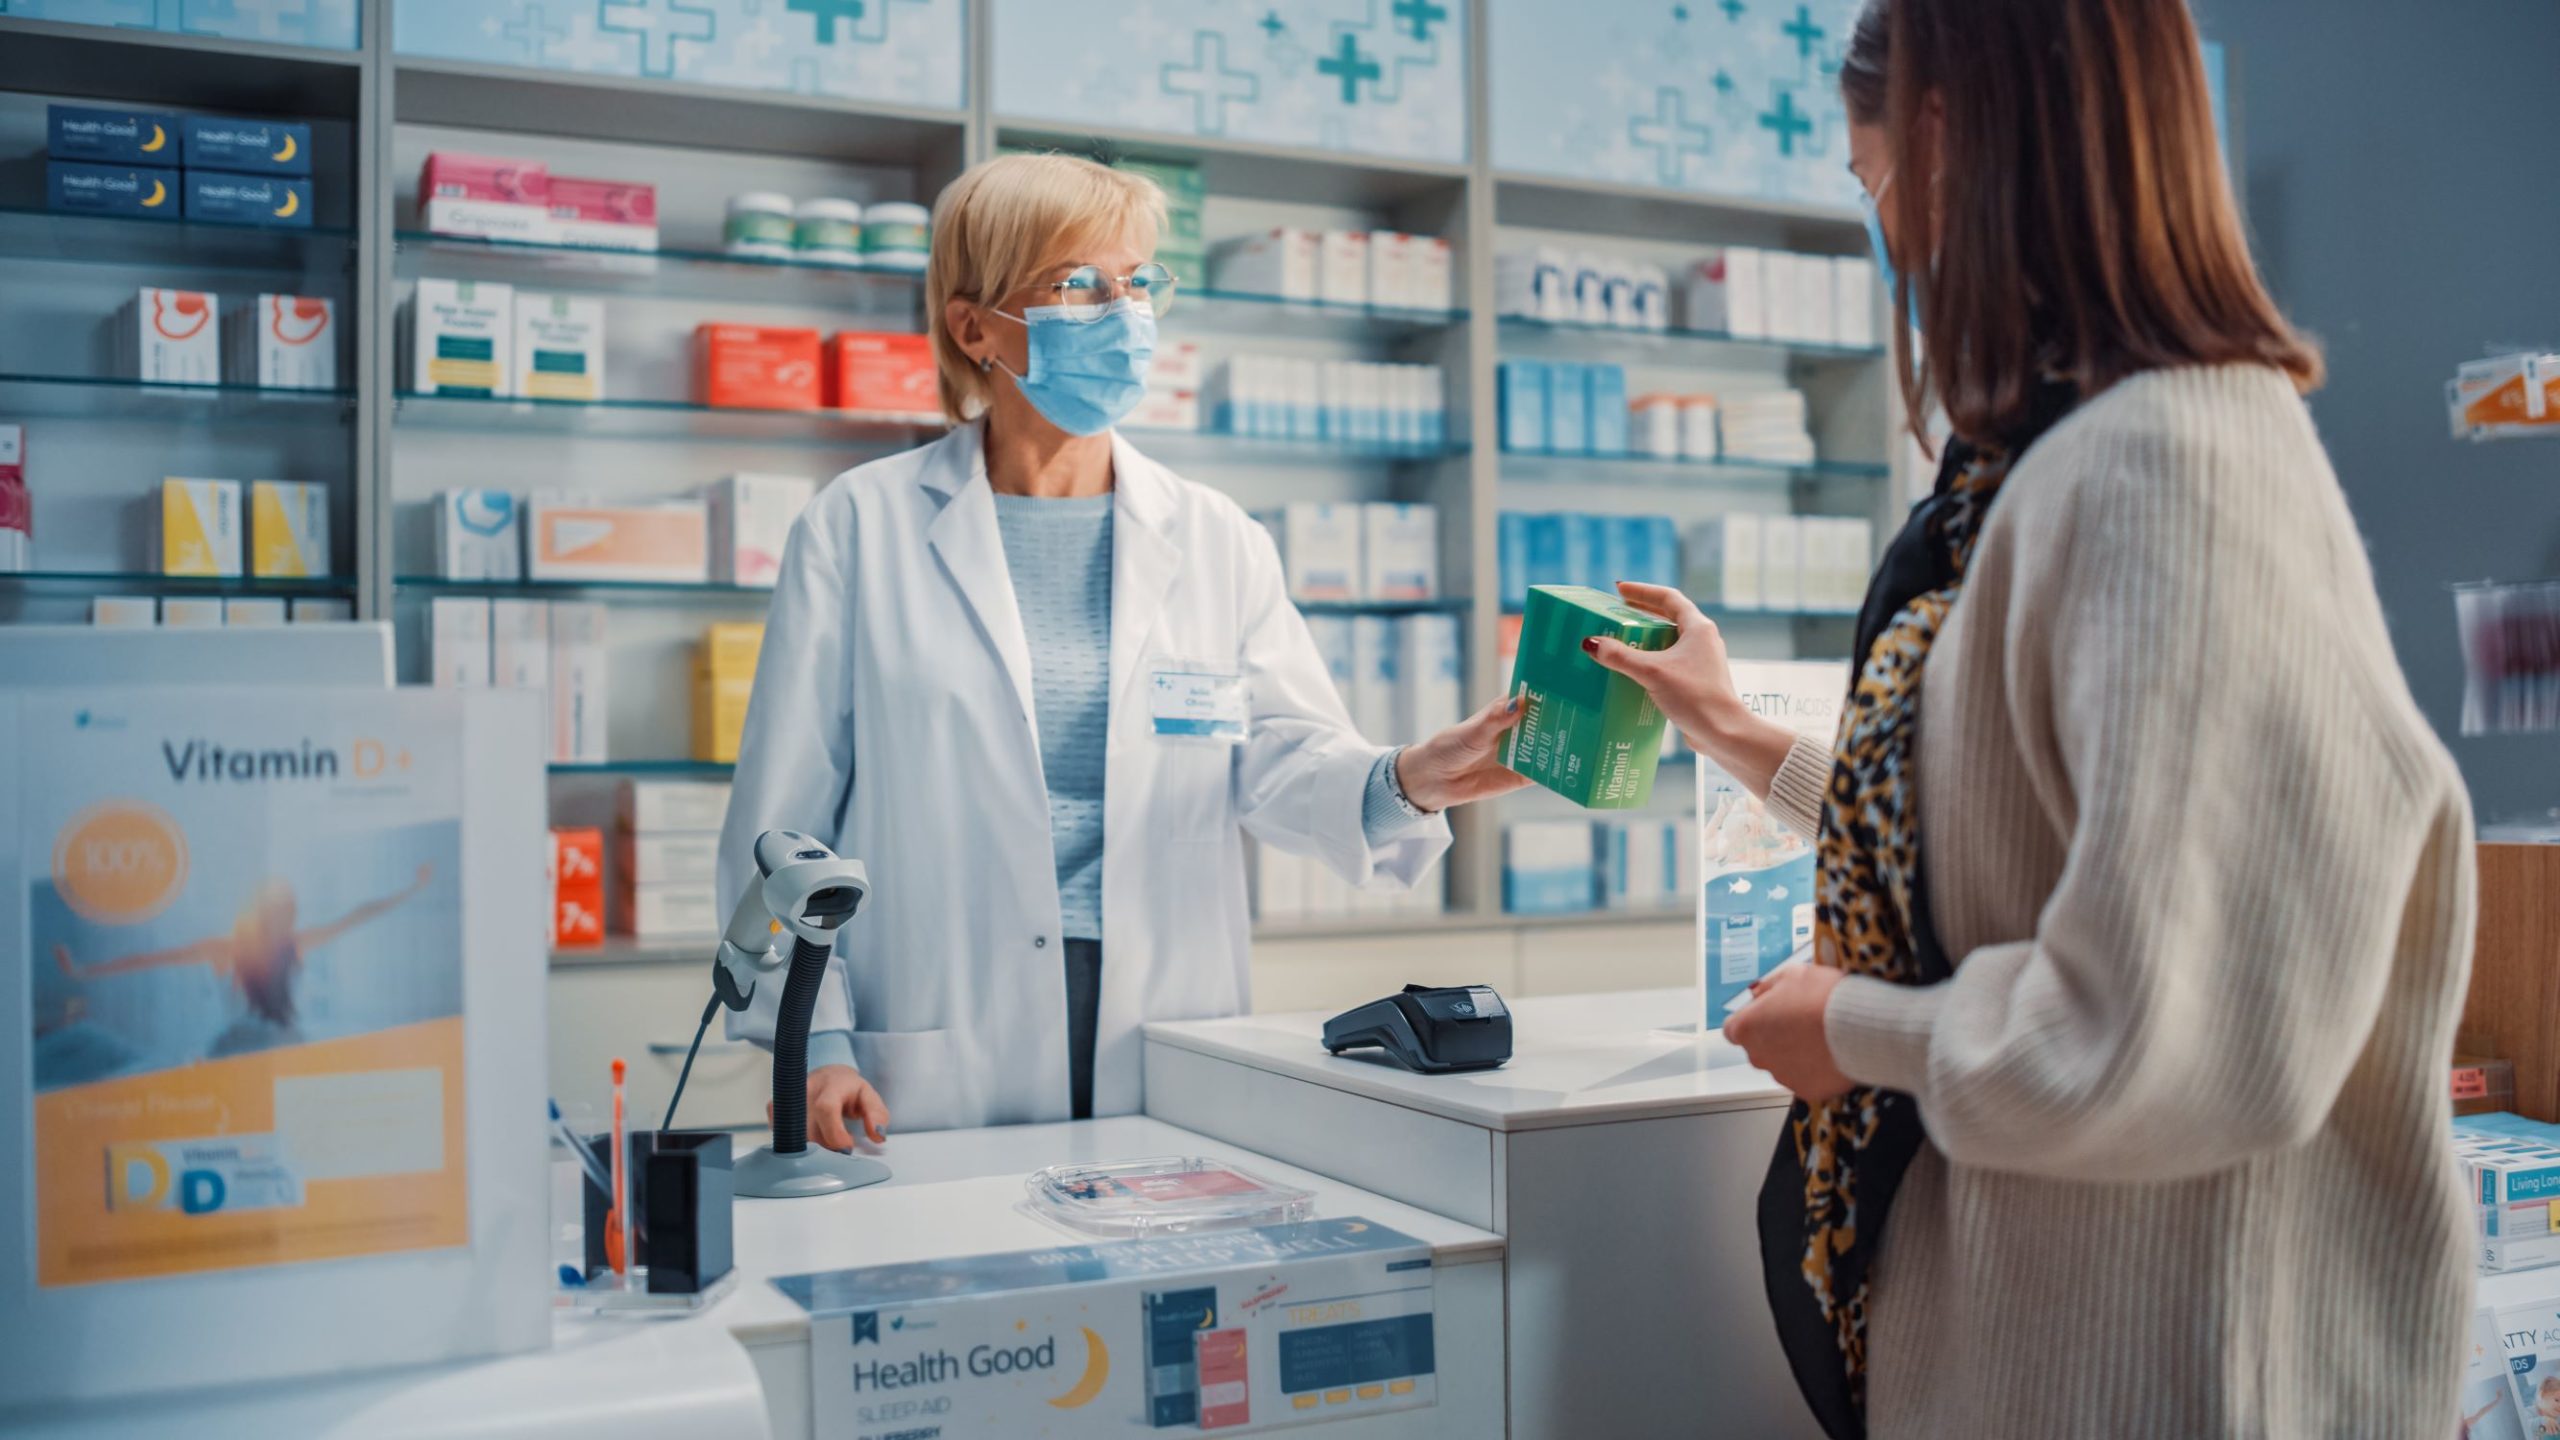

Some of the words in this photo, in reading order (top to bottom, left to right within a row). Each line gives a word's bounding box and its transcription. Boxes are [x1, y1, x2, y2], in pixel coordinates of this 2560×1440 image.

[62, 119, 101, 135] Health
[104, 120, 138, 137] Good
[62, 173, 101, 189] Health
[104, 175, 138, 192] Good
[1528, 689, 1543, 701] E
[1795, 698, 1832, 716] ACIDS
[1518, 704, 1540, 763] Vitamin
[1616, 741, 1631, 750] E
[162, 738, 339, 782] Vitamin
[1536, 744, 1550, 771] 400
[1567, 754, 1577, 773] 150
[1606, 752, 1627, 801] Vitamin
[1625, 777, 1638, 799] 400
[84, 839, 166, 875] 100%
[2512, 1178, 2540, 1192] Living
[1287, 1301, 1362, 1326] TREATS
[853, 1349, 960, 1392] Health
[968, 1336, 1055, 1378] Good
[857, 1400, 918, 1426] SLEEP
[920, 1396, 953, 1415] AID
